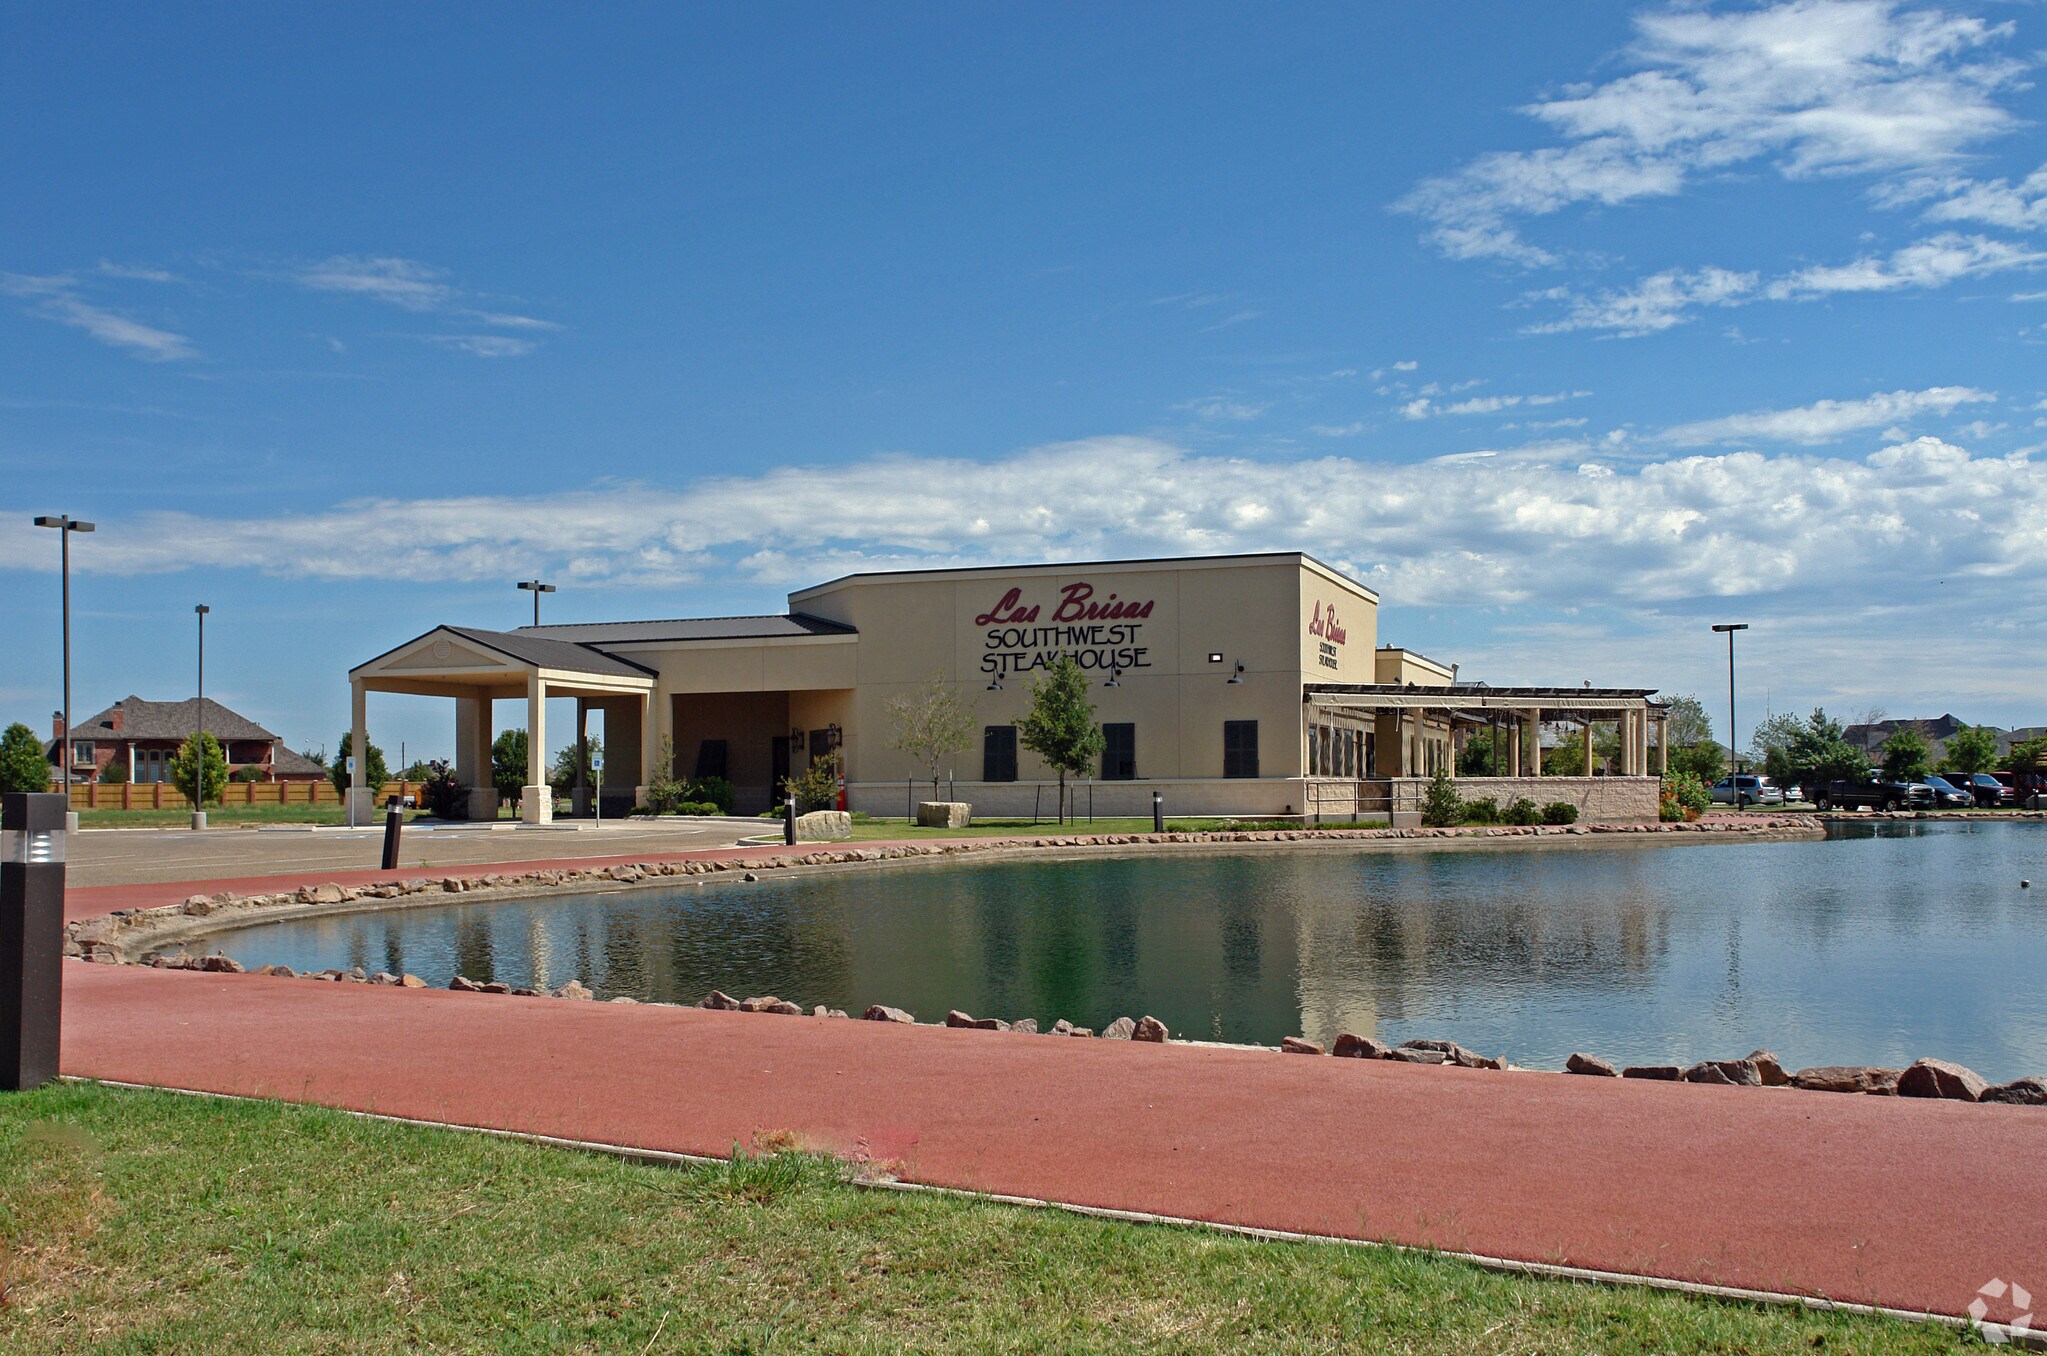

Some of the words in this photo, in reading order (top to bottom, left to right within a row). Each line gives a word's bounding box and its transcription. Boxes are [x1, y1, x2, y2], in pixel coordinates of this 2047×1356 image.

[975, 587, 1041, 627] Las
[1052, 582, 1155, 622] Brisas
[985, 624, 1142, 649] SOUTHWEST
